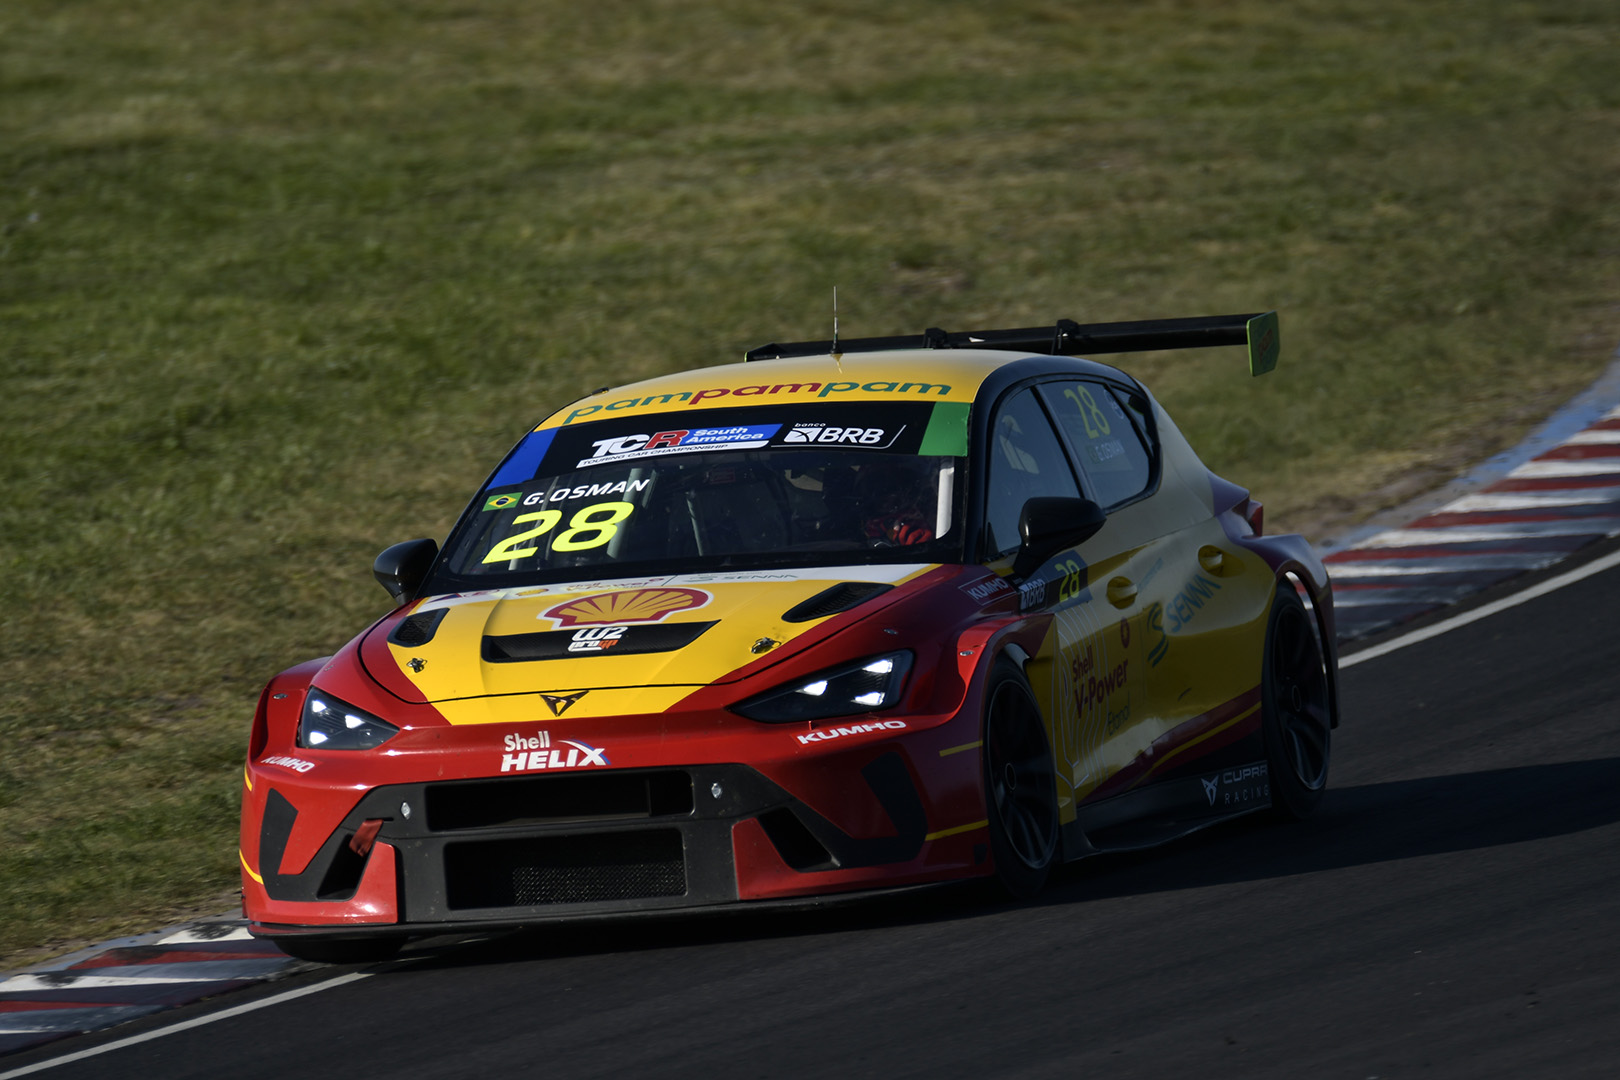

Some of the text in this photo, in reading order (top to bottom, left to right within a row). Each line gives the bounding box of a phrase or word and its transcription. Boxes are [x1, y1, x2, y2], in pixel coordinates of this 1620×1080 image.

[1064, 385, 1110, 439] 28
[686, 432, 764, 444] America
[693, 427, 748, 437] South
[817, 427, 884, 444] BRB
[582, 444, 729, 466] TOURING CAR CHAMPIONSHIP
[591, 430, 689, 458] TCR
[482, 501, 635, 564] 28
[967, 577, 1009, 600] KUMHO
[1054, 559, 1081, 602] 28
[1166, 574, 1222, 633] SENNA
[571, 626, 628, 641] W2
[1072, 644, 1094, 682] Shell
[1074, 658, 1128, 719] V-Power
[504, 730, 550, 752] Shell
[797, 720, 907, 744] KUMHO
[260, 756, 315, 773] KUMHO
[501, 747, 607, 772] HELIX
[1223, 764, 1268, 784] CUPRA
[1224, 784, 1269, 805] RACING
